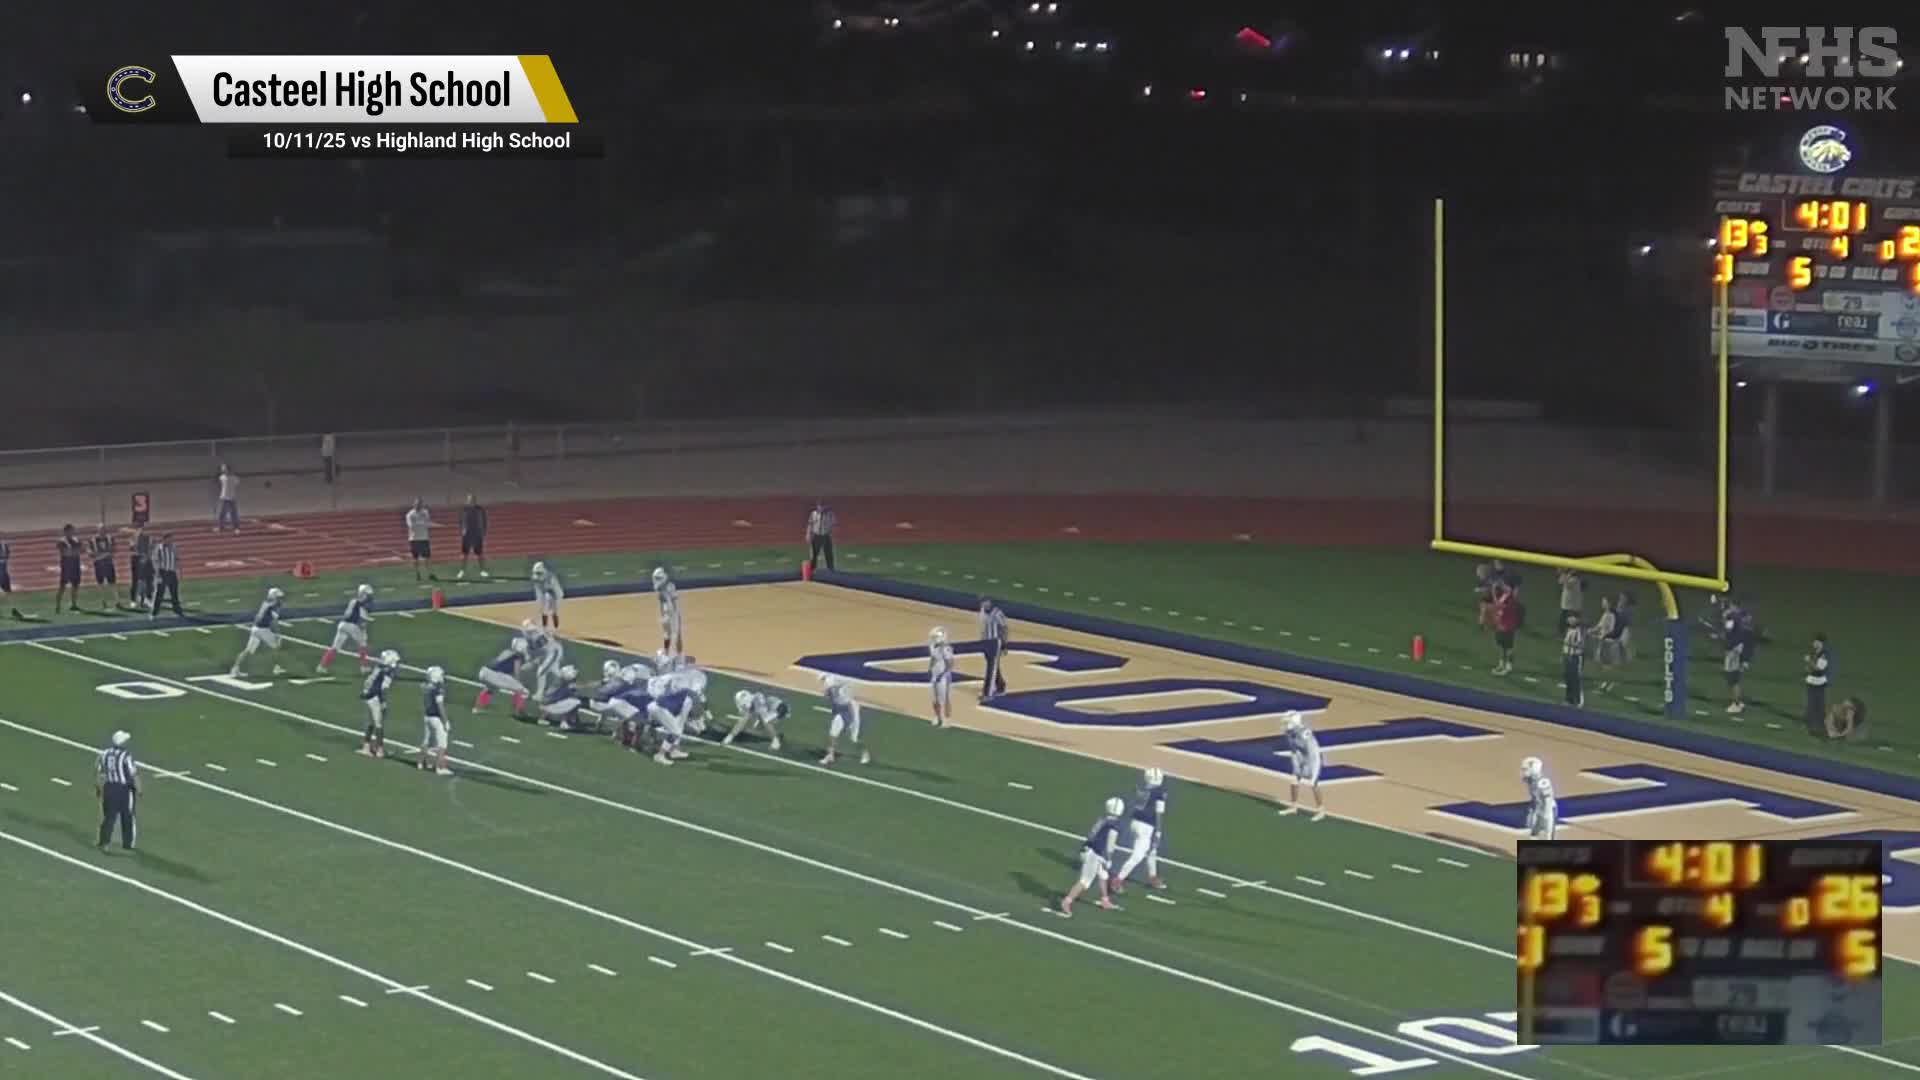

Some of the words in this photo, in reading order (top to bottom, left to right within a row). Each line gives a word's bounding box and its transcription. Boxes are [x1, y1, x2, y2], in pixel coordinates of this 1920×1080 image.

[1738, 172, 1834, 194] CASTEEL
[1799, 200, 1867, 230] 4:01
[1790, 256, 1812, 287] 5
